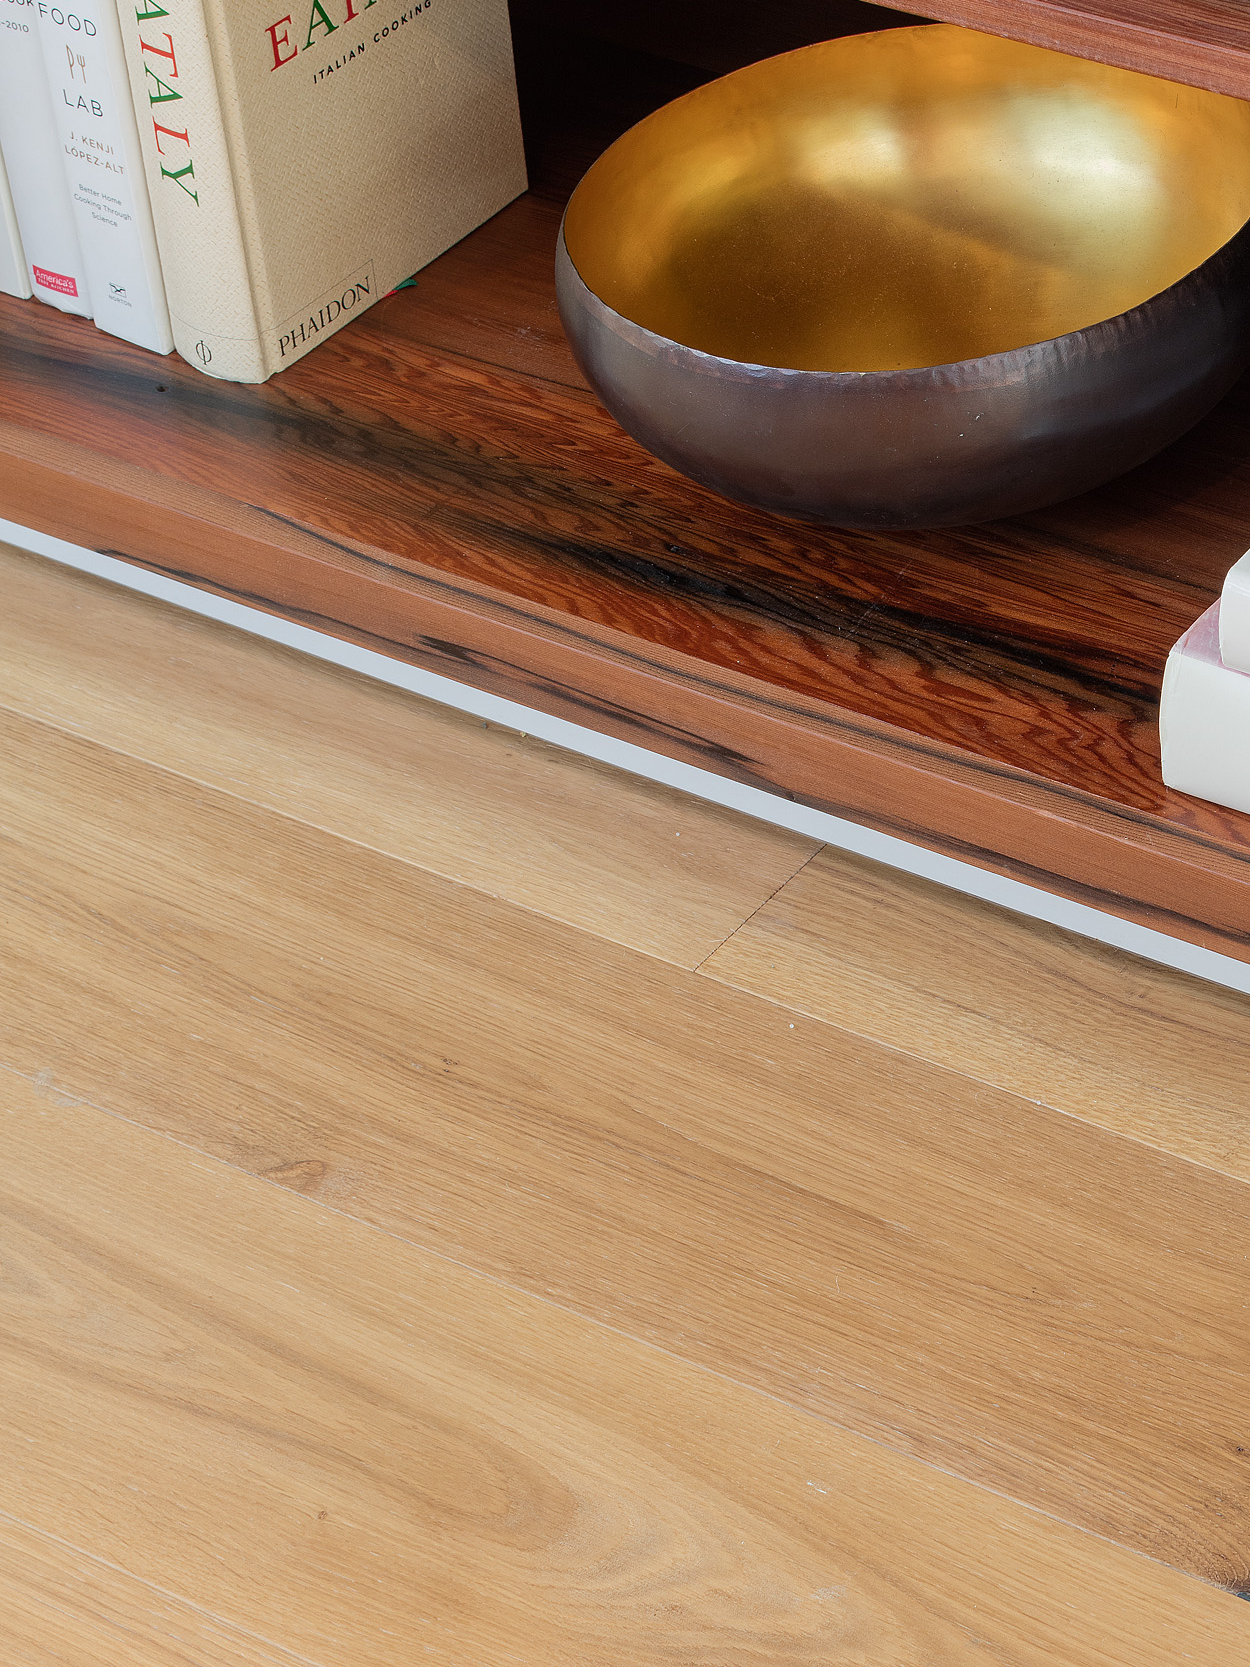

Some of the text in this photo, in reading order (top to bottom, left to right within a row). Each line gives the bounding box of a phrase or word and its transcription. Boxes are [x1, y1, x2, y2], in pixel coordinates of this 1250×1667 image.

[38, 2, 96, 36] FOOD
[314, 43, 364, 84] ITALIAN
[63, 89, 103, 117] LAB
[70, 131, 113, 155] J. KENJI
[74, 194, 101, 210] Cooking
[102, 193, 121, 205] Home
[279, 276, 370, 356] PHAIDON
